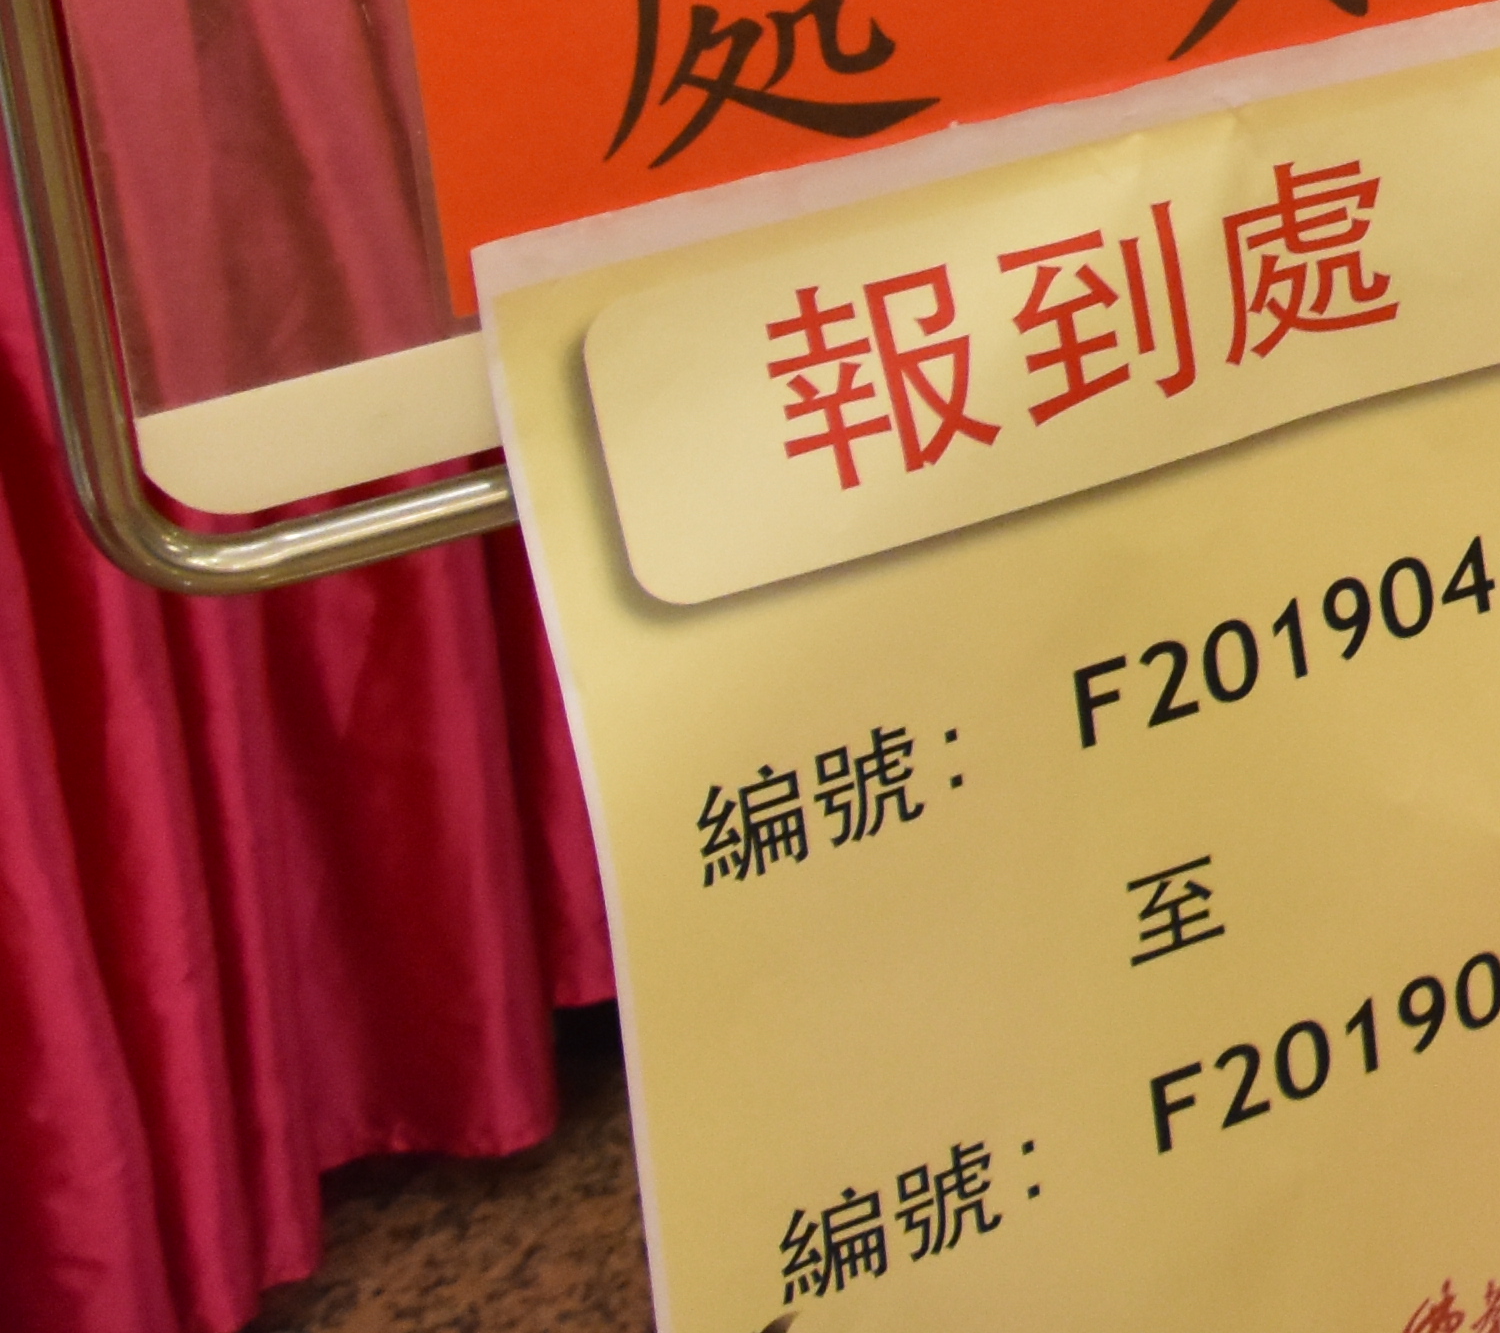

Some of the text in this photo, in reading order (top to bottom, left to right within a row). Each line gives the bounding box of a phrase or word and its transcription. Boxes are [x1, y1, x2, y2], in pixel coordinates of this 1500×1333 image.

[765, 159, 1401, 490] 報到處
[1127, 855, 1226, 967] 至
